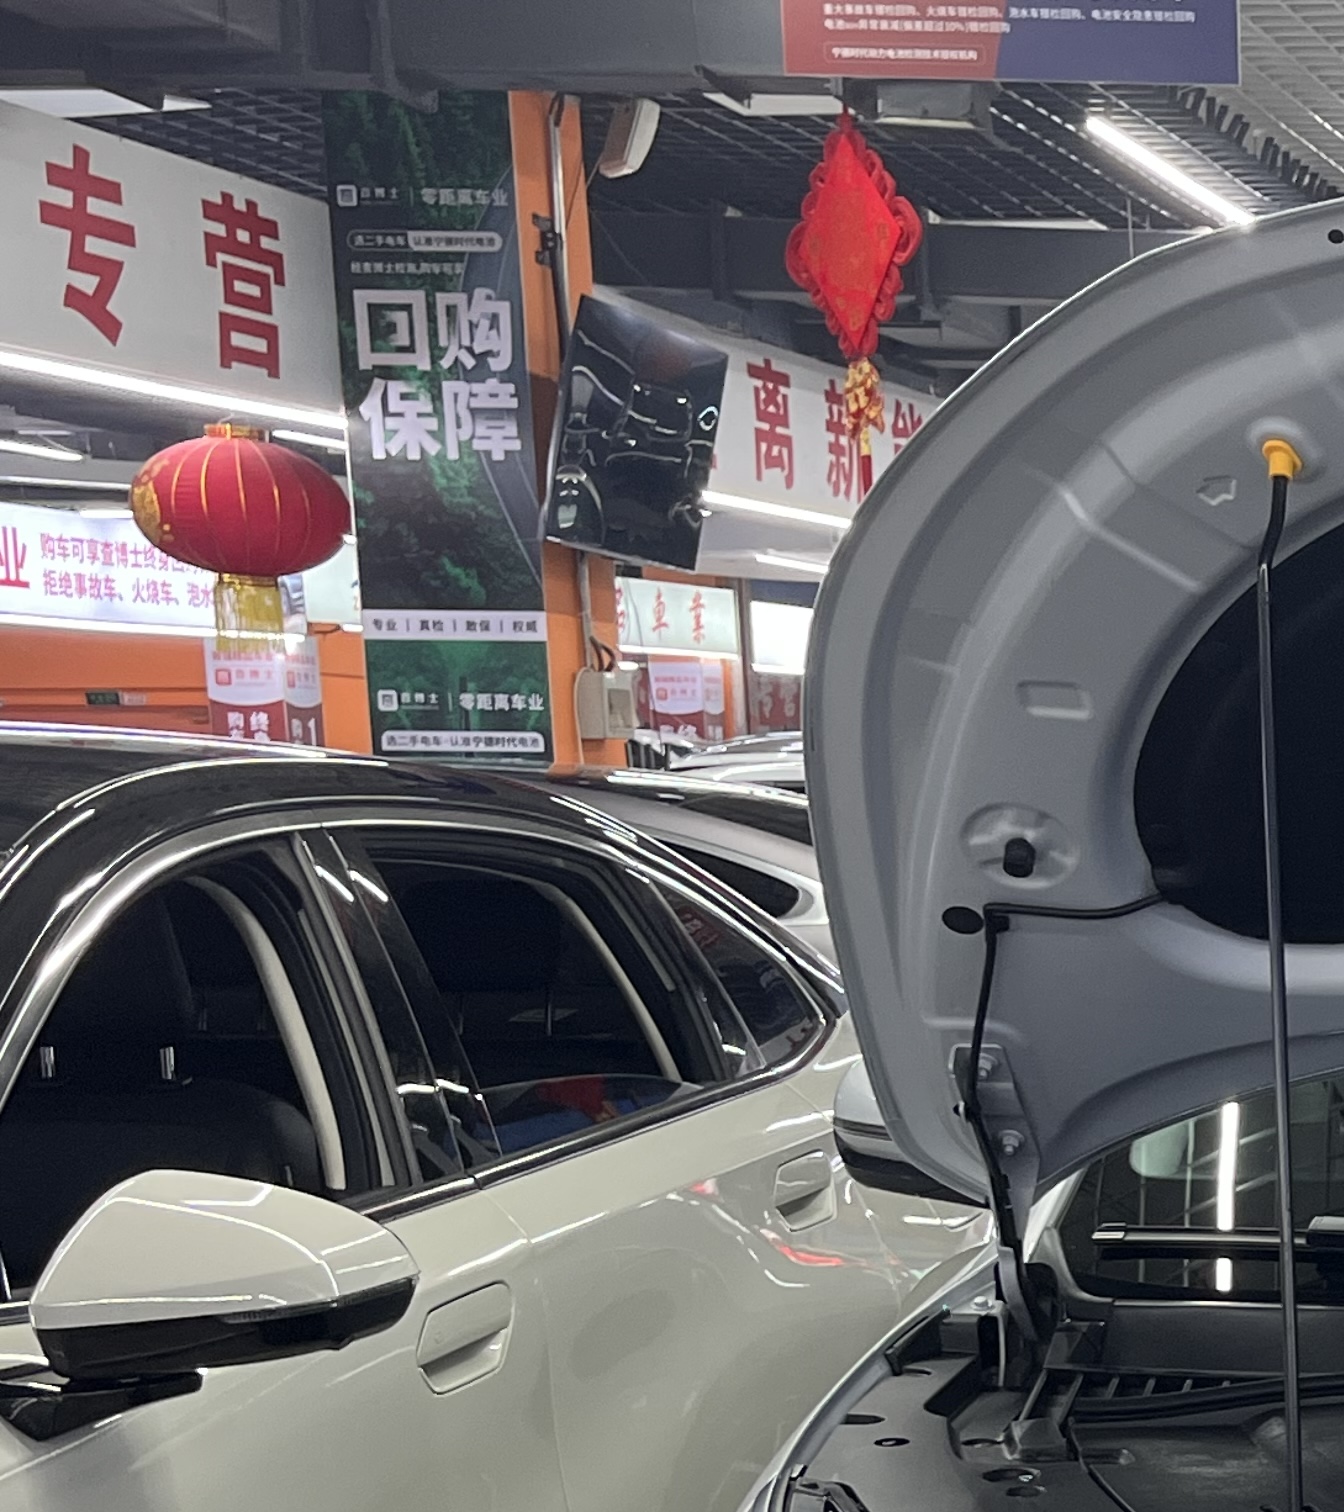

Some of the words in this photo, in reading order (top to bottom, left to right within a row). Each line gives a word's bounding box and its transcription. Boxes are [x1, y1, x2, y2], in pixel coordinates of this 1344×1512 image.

[39, 144, 286, 379] 专营
[353, 287, 513, 372] 回购
[359, 376, 522, 461] 保障
[459, 692, 545, 711] 零距离车业
